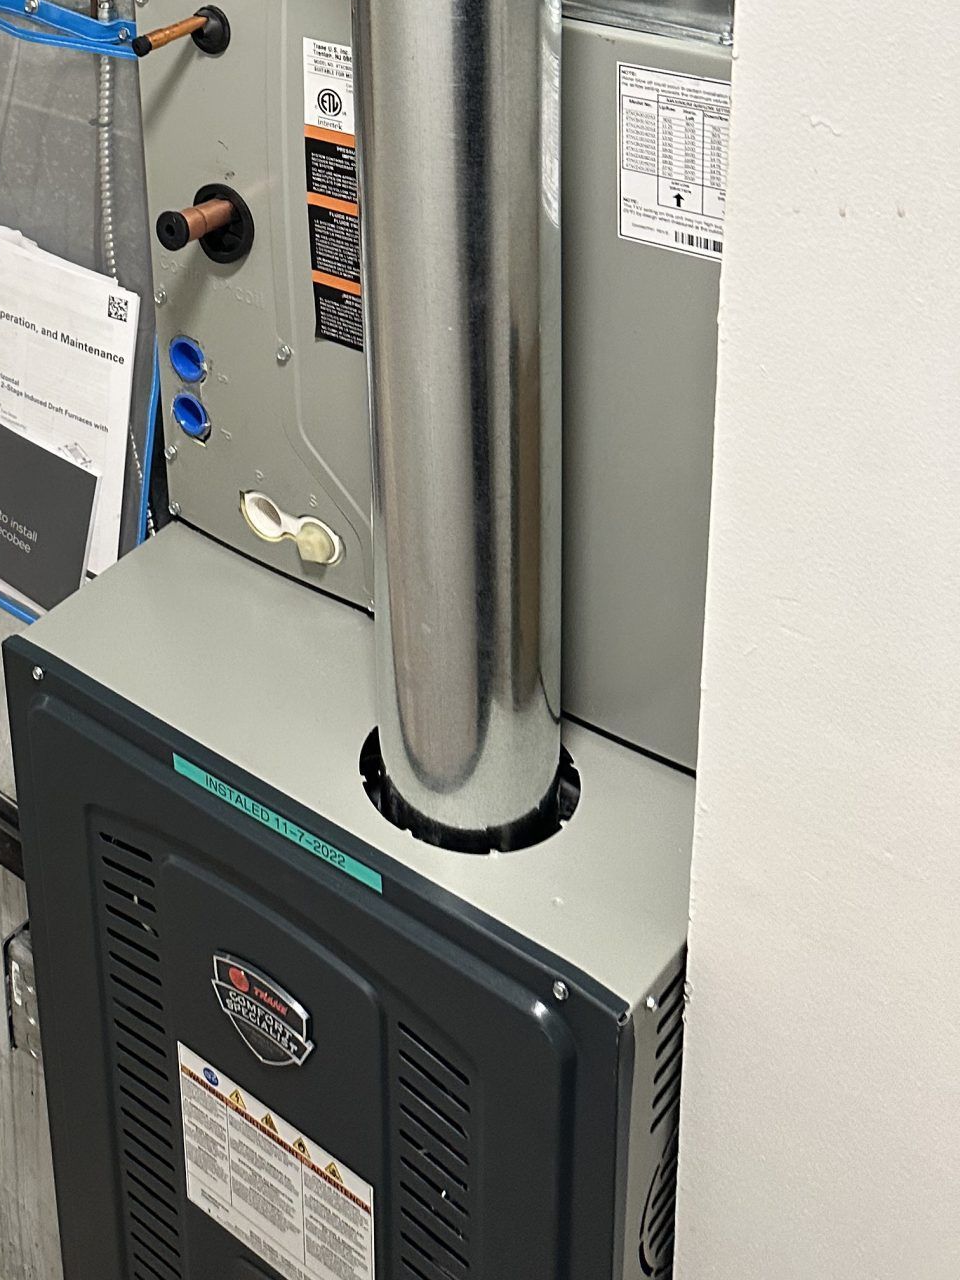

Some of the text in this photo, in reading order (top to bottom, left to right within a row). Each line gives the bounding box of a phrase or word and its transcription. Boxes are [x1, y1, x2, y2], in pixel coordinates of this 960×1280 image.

[41, 327, 58, 340] and
[60, 333, 125, 365] Maintenance
[0, 380, 23, 398] 2-Stage
[24, 392, 47, 408] Induced
[48, 402, 64, 415] Draft
[64, 409, 93, 427] Furnaces
[94, 421, 109, 433] with
[0, 510, 8, 523] to
[10, 517, 38, 543] install
[205, 774, 346, 869] INSTALED 11-7-2022
[225, 998, 298, 1054] SPECIALIST
[229, 990, 293, 1039] COMFORT
